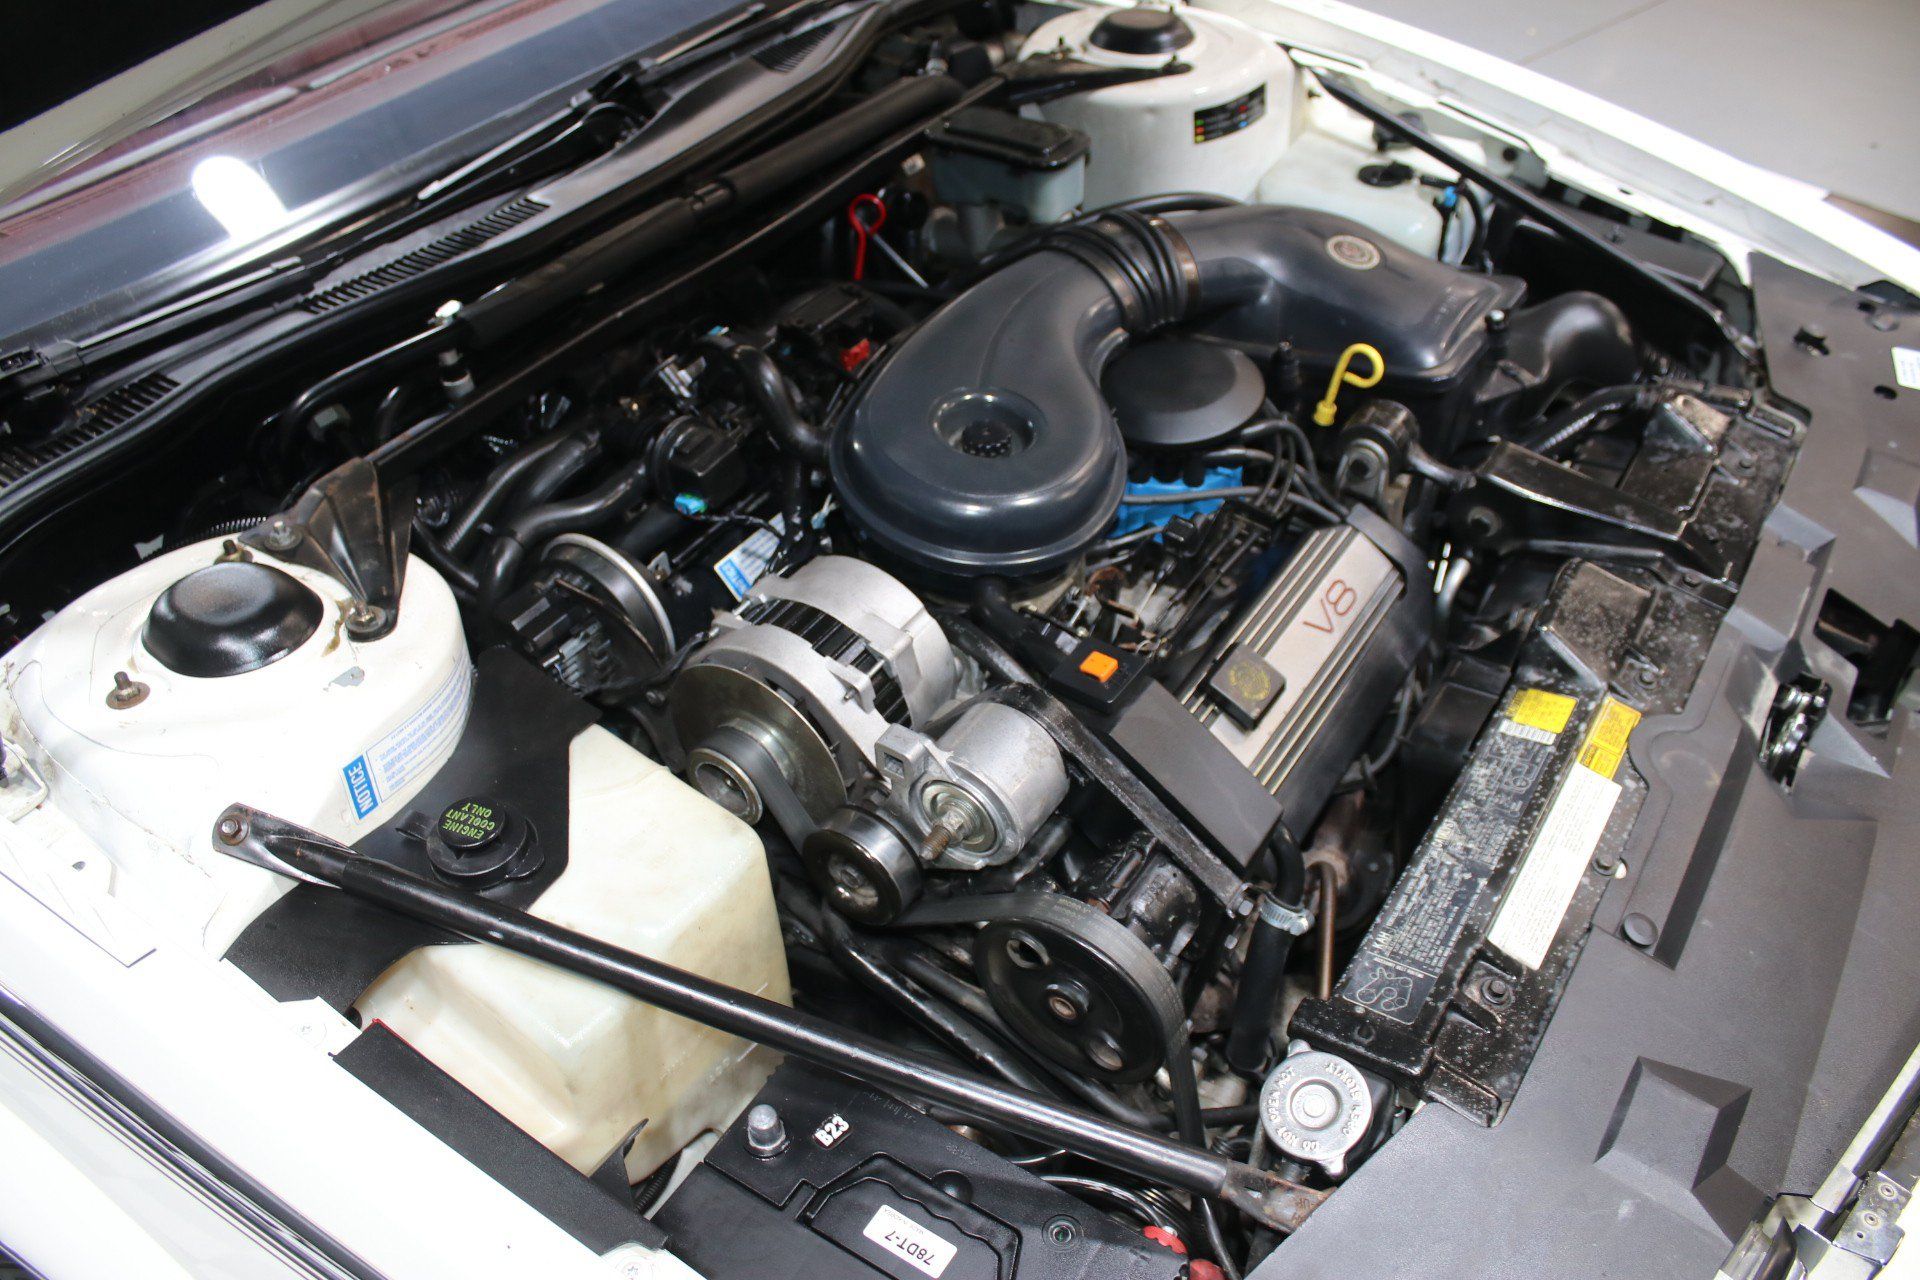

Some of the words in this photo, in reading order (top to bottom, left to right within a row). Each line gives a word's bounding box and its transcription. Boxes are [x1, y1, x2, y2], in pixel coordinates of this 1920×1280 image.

[1303, 579, 1357, 633] V8
[348, 762, 374, 813] NOTICE
[445, 809, 496, 831] COOLANT
[461, 802, 492, 818] ONLY
[442, 819, 485, 840] ENGINE
[814, 1115, 850, 1147] B23
[1276, 1126, 1300, 1147] NOT
[884, 1230, 935, 1266] 78DT-7
